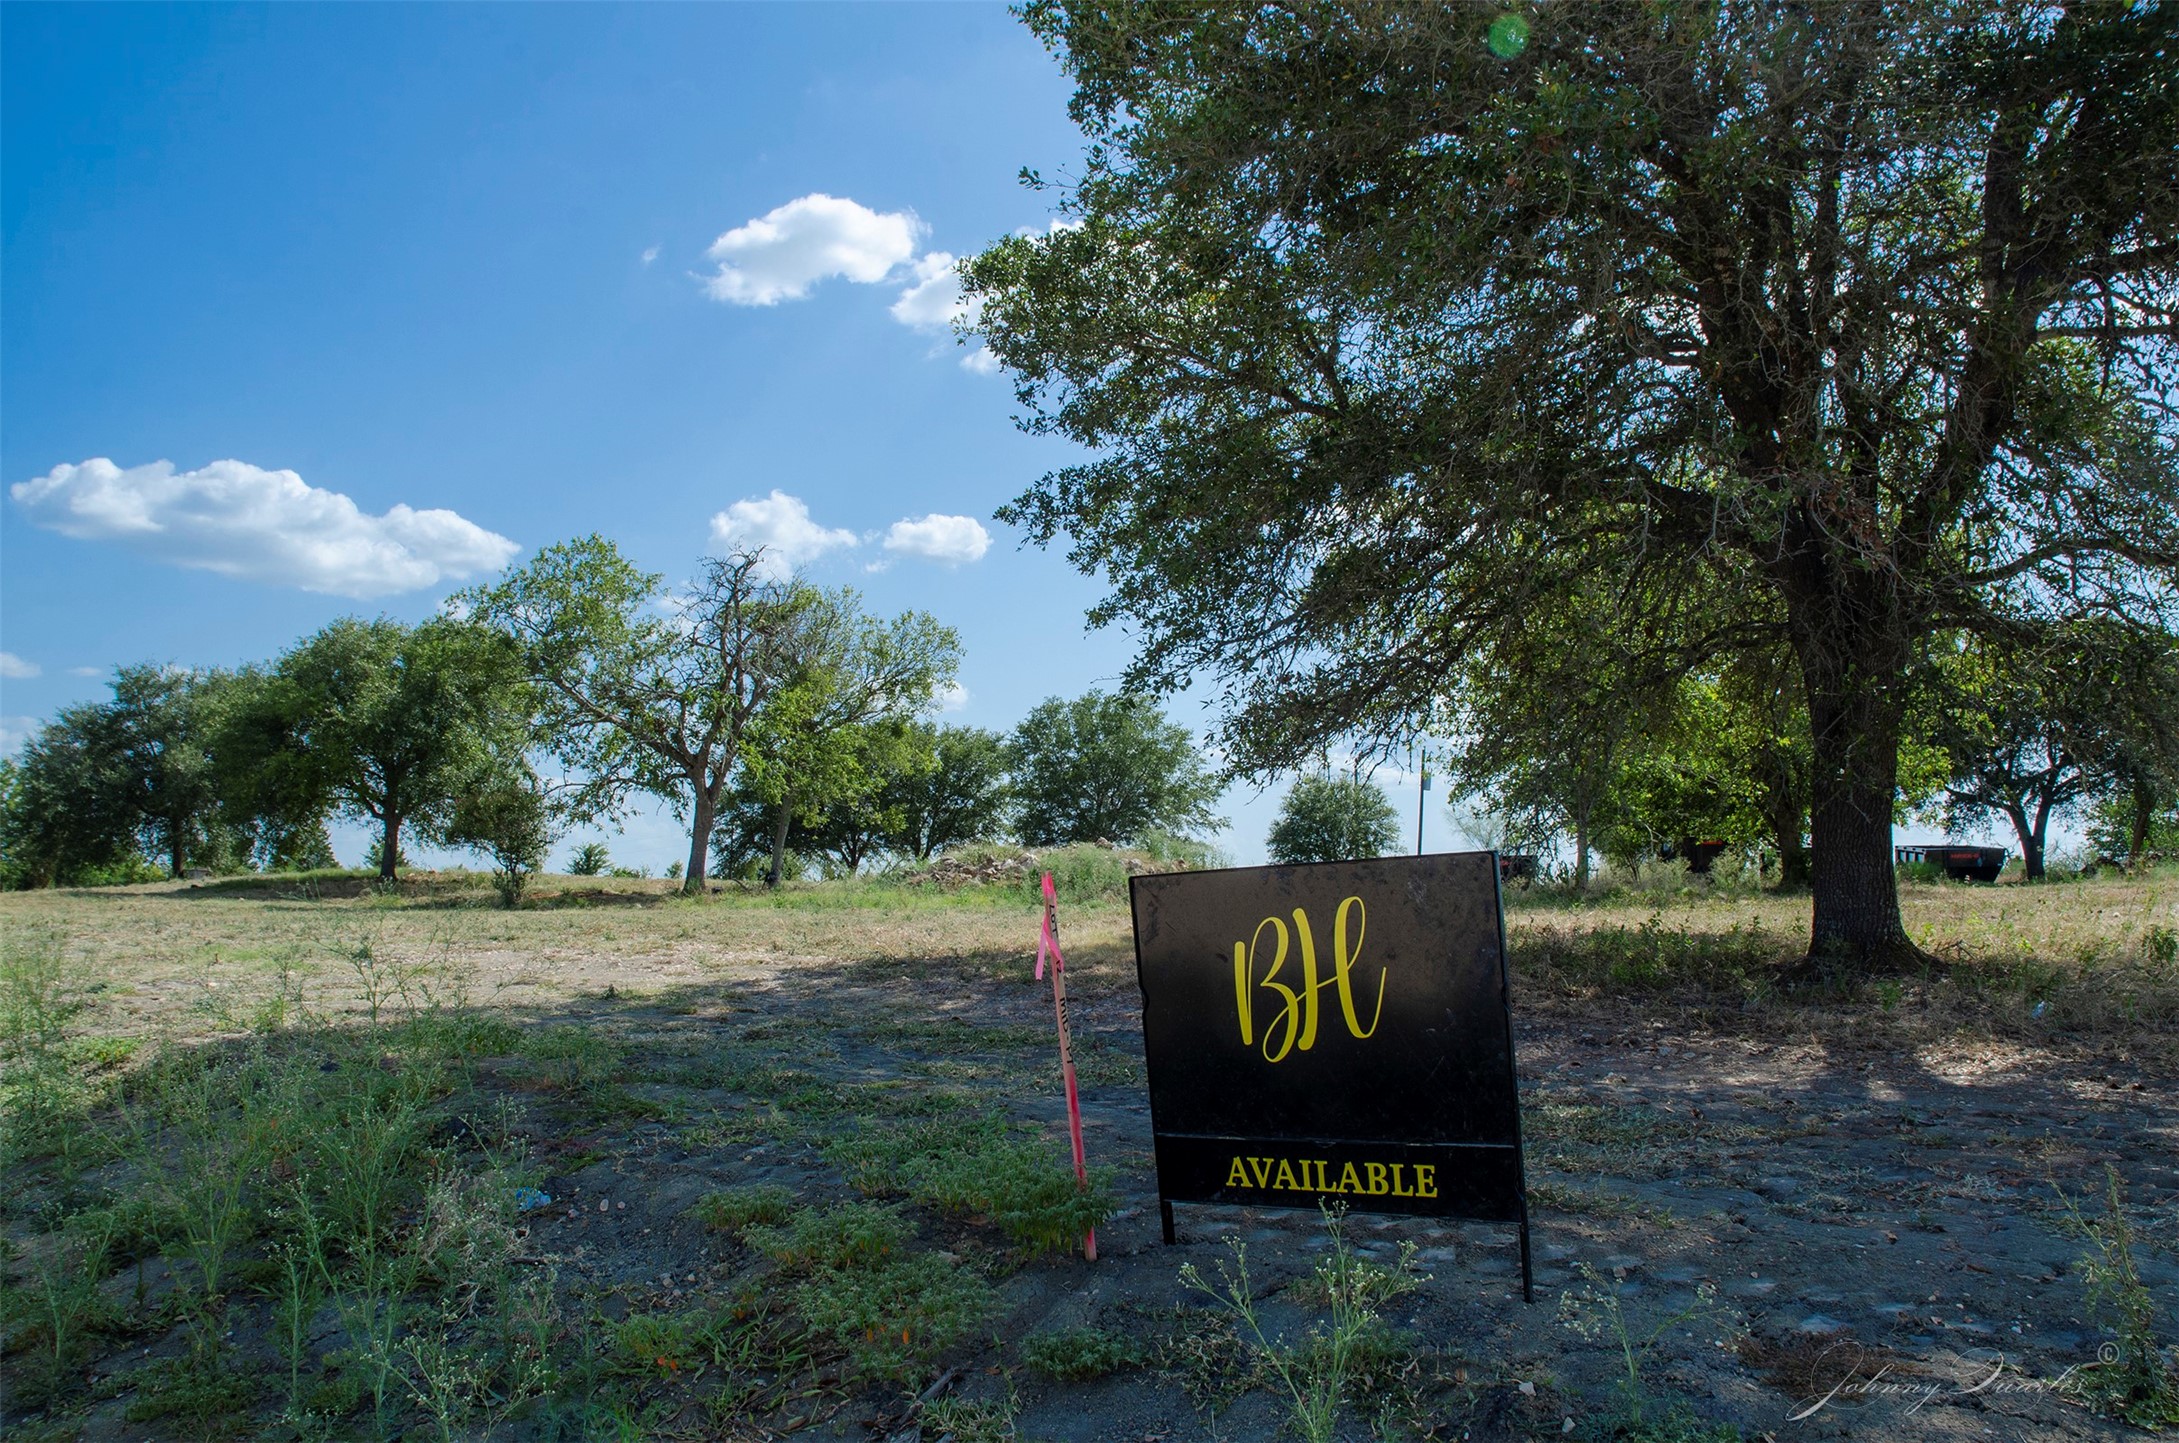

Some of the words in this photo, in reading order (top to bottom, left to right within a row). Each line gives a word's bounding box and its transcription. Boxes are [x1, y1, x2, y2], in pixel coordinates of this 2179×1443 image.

[1049, 904, 1059, 938] LOT
[1234, 896, 1387, 1063] BH
[1226, 1156, 1438, 1198] AVAILABLE
